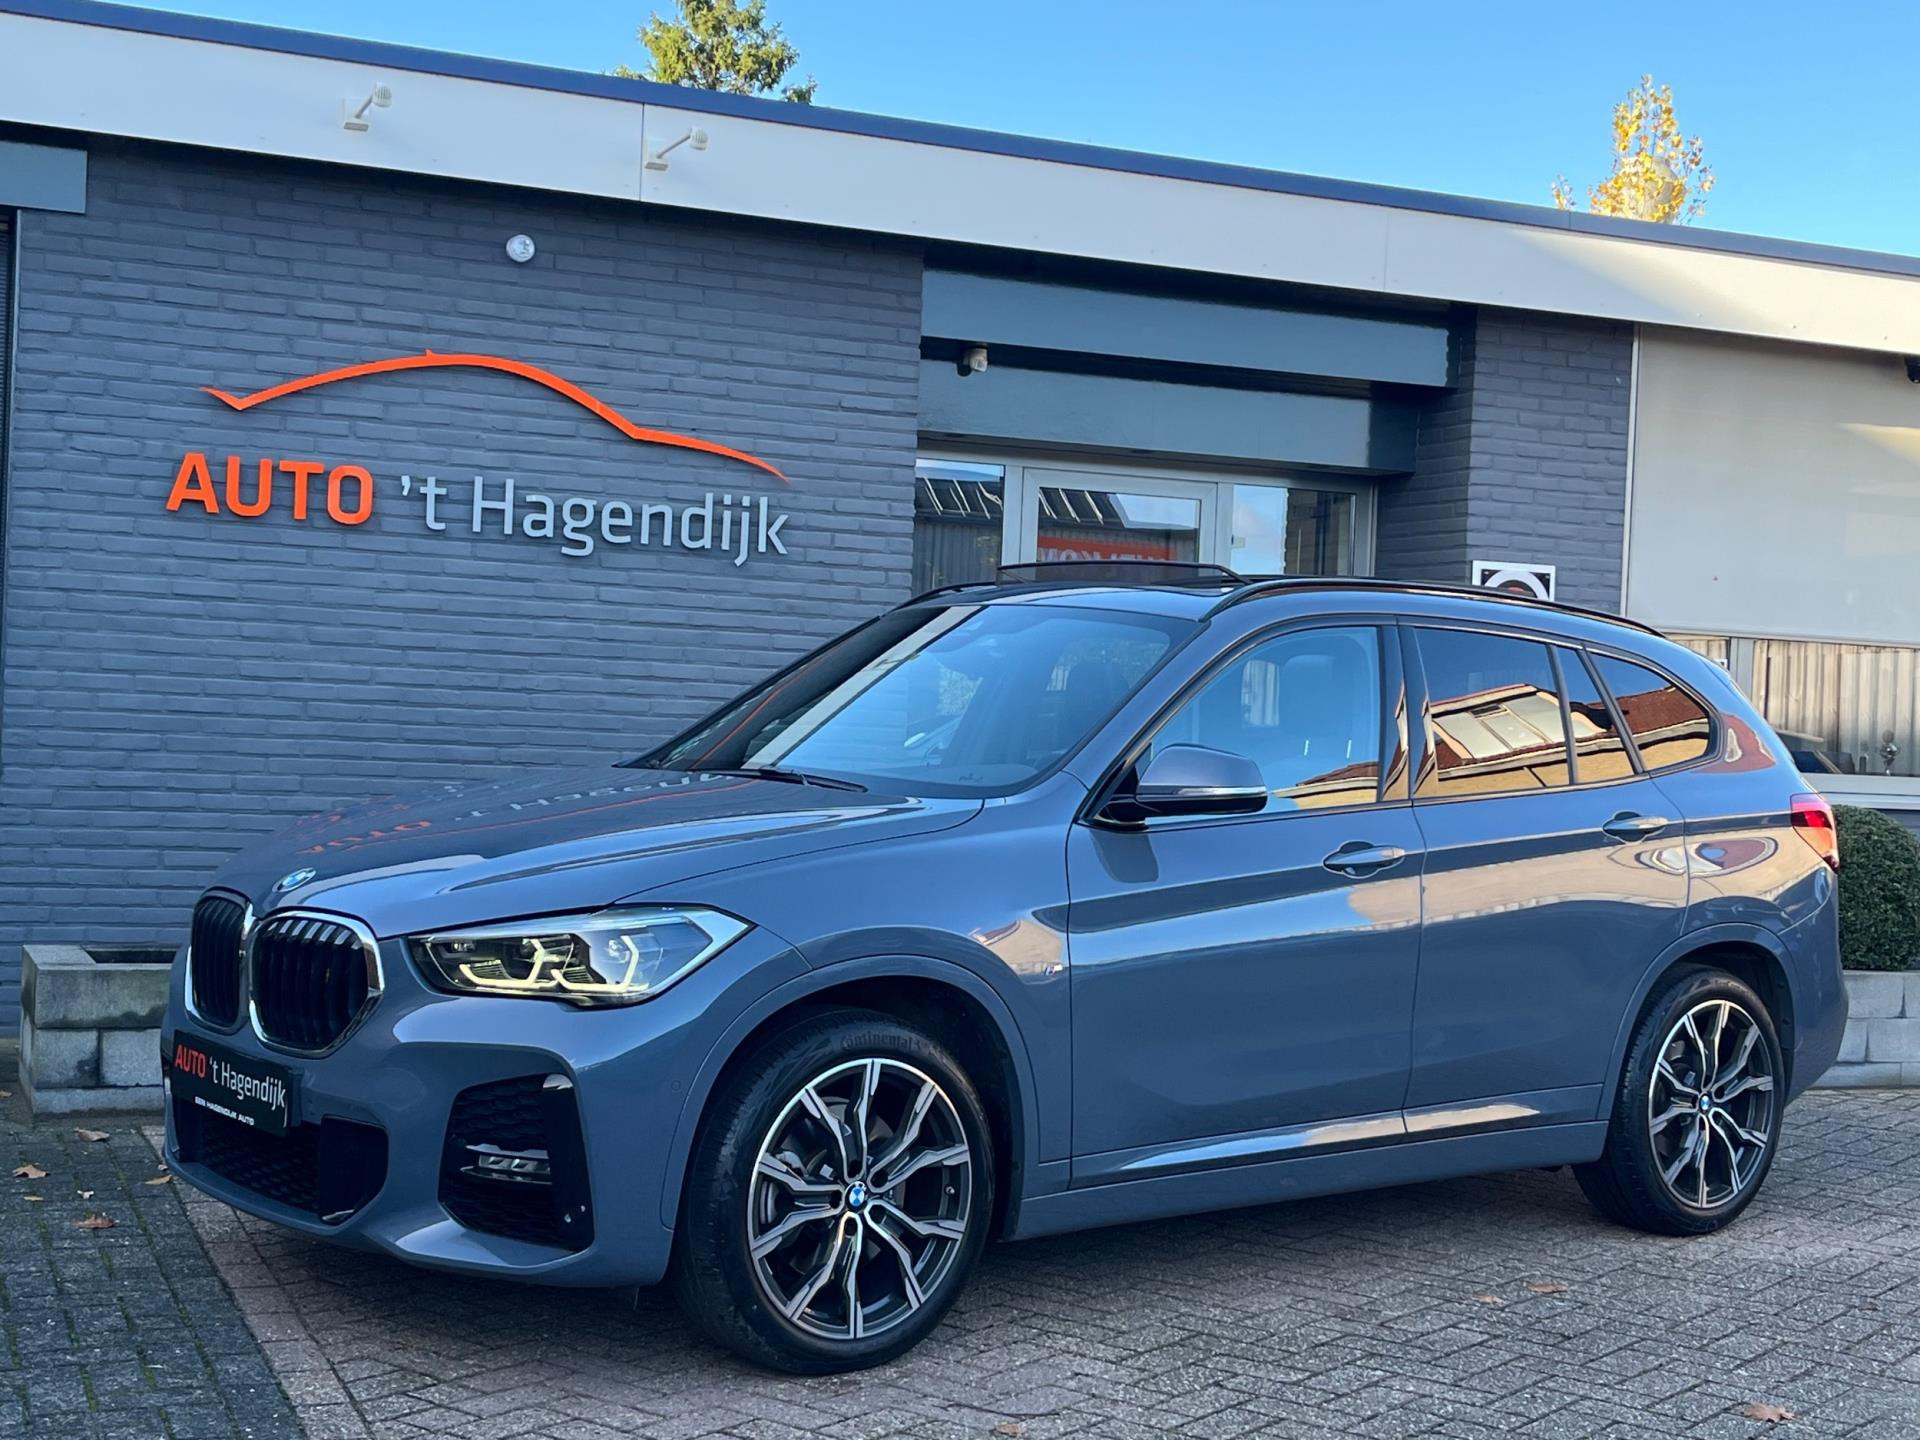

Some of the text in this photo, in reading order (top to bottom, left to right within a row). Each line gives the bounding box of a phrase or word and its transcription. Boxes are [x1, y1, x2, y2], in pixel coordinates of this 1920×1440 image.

[166, 452, 790, 567] AUTO 't Hagendijk
[174, 1043, 207, 1079] AUTO
[221, 1061, 286, 1111] Hagendijk
